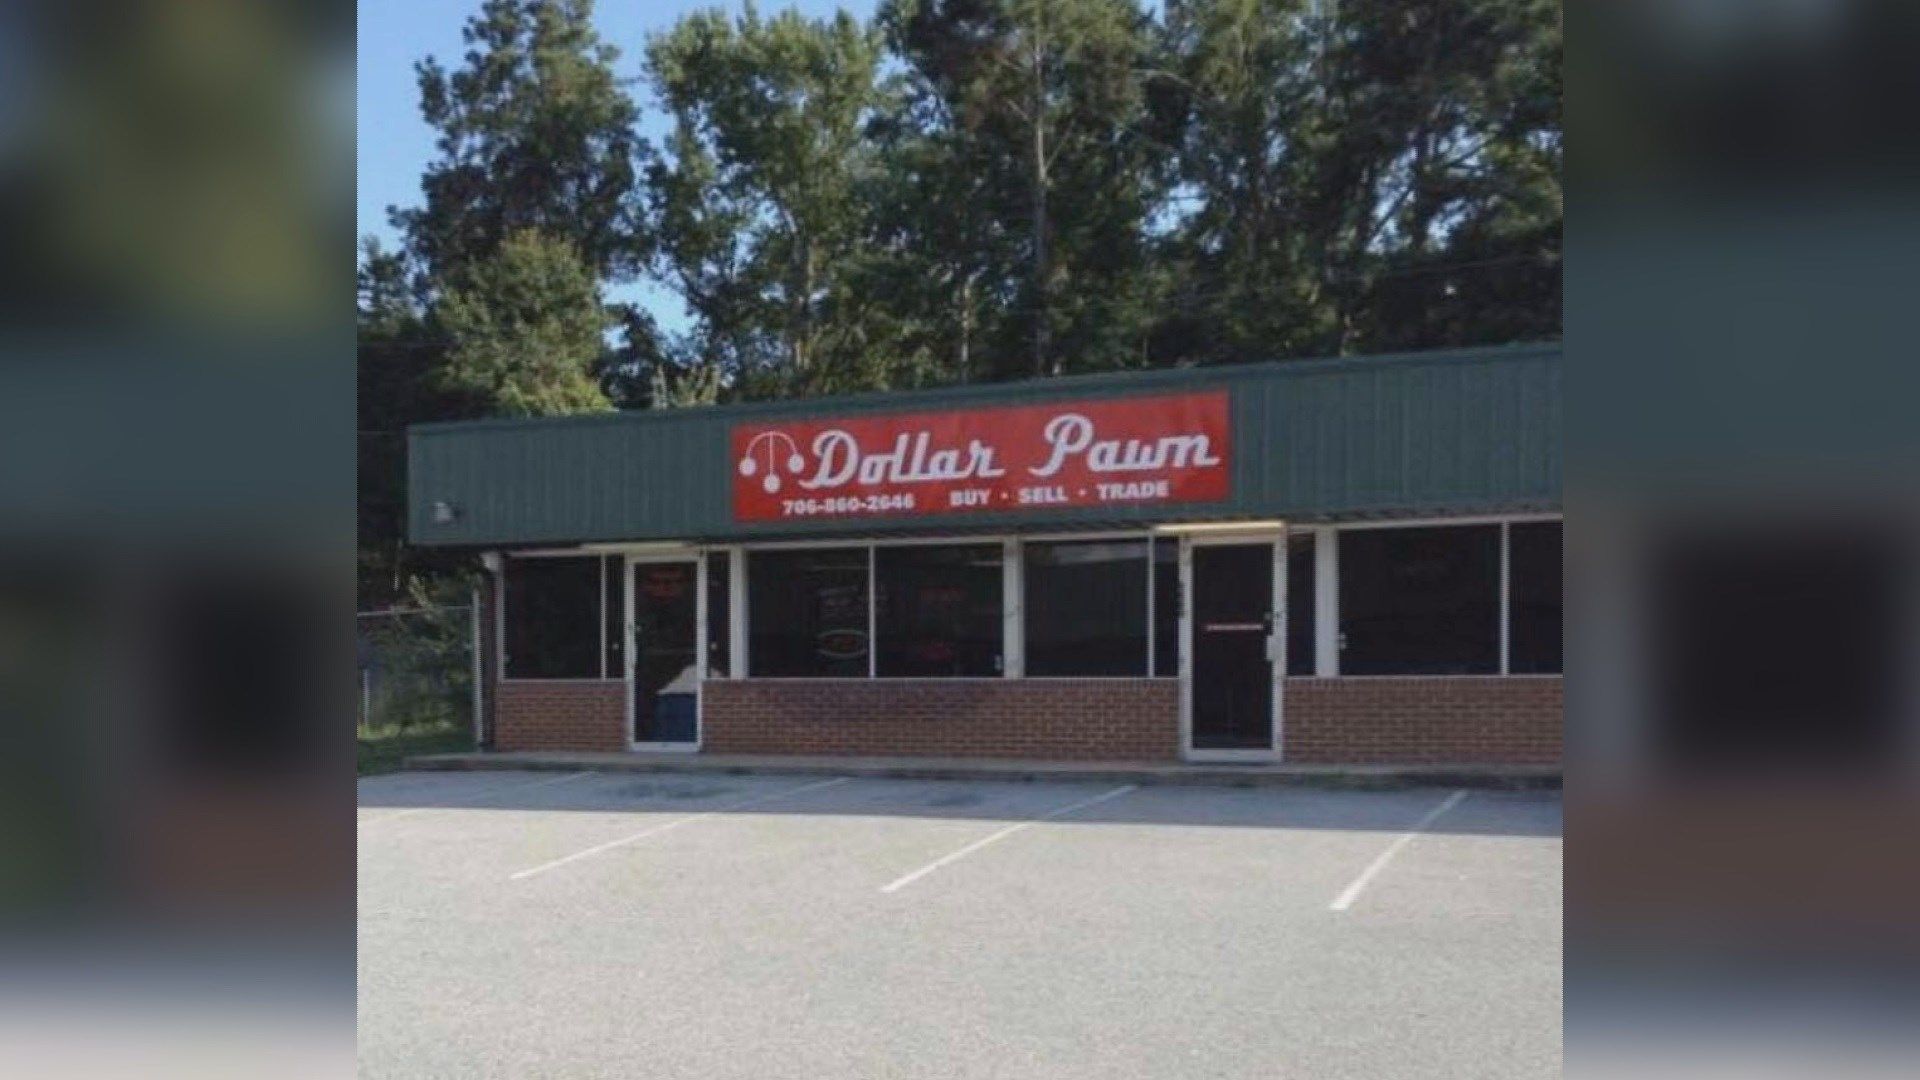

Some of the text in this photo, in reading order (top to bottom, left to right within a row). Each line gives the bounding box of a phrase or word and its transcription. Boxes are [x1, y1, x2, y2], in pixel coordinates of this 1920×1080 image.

[799, 413, 1221, 490] Dollar Pawn
[782, 492, 915, 515] 706-860-2646
[949, 480, 1169, 507] BUY SELL TRADE
